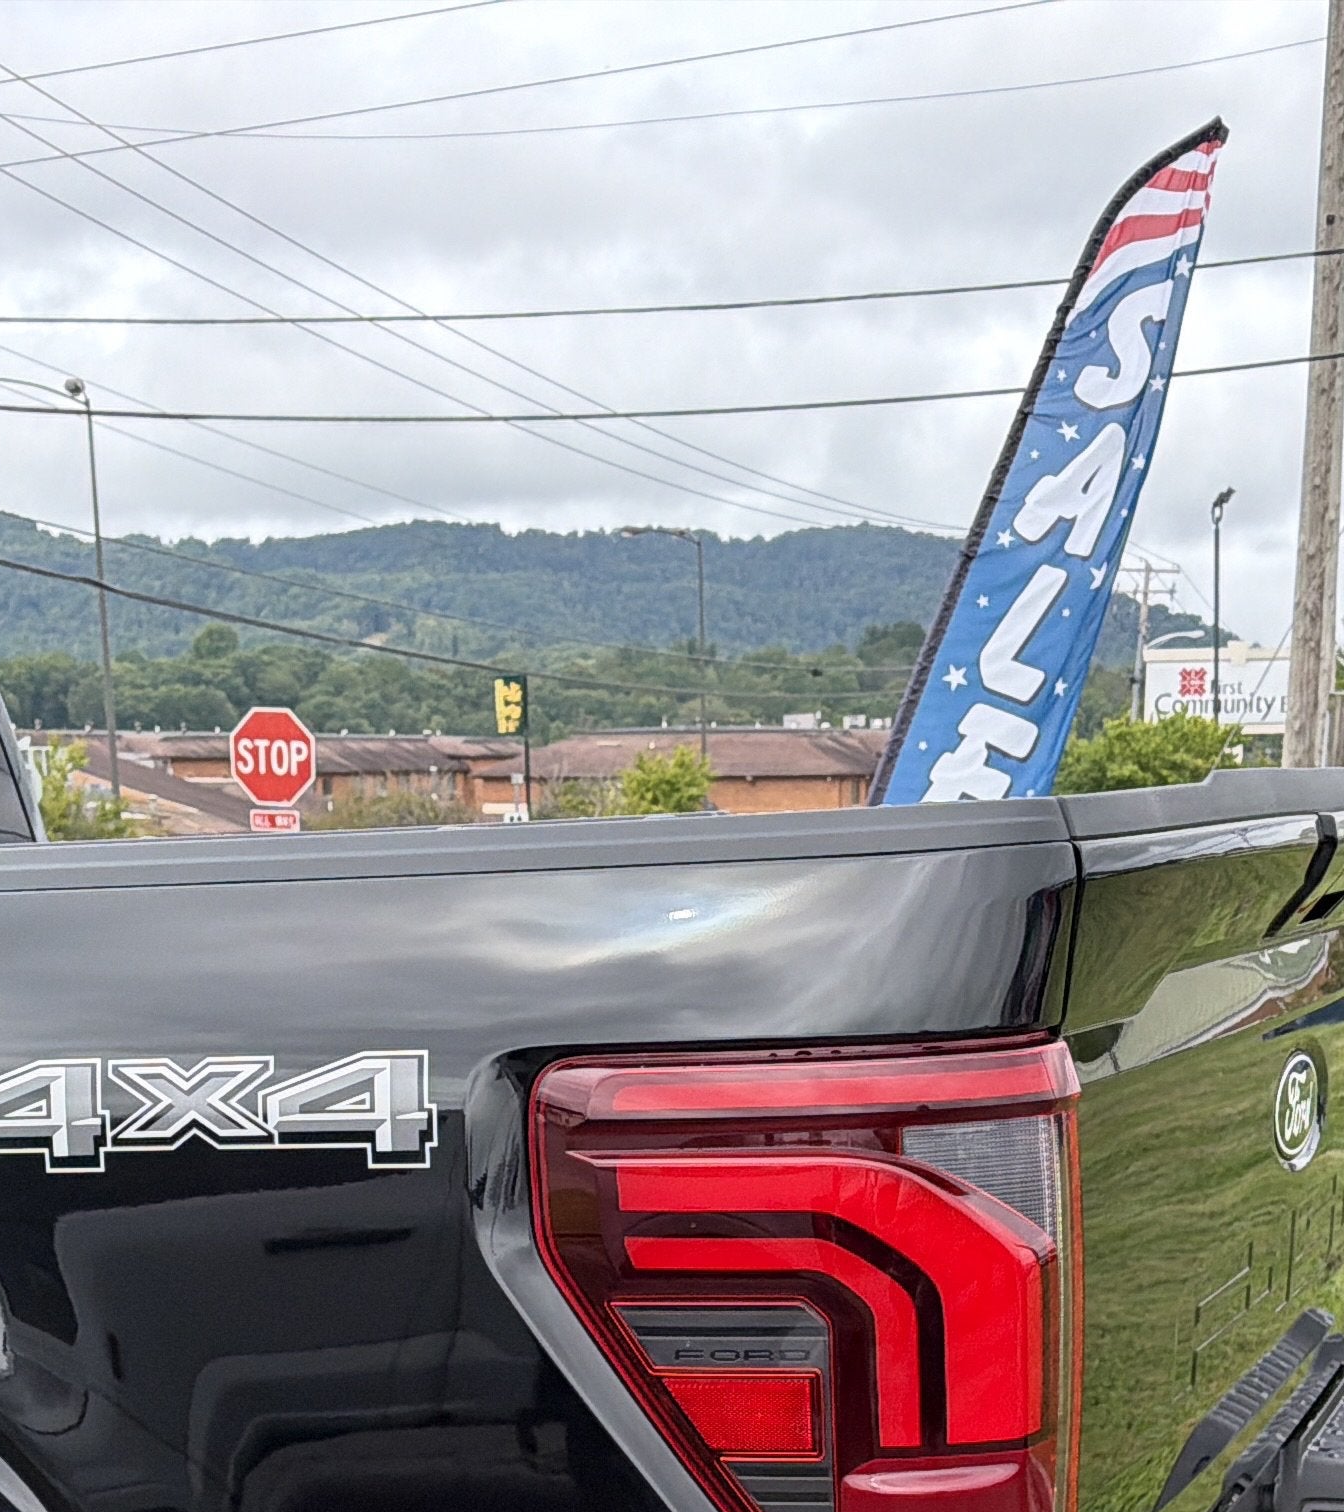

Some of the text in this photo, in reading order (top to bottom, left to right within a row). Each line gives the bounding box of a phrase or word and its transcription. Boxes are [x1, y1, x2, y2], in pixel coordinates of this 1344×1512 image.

[1154, 692, 1276, 721] Community
[236, 737, 309, 777] STOP
[1284, 1068, 1314, 1143] Ford
[675, 1349, 810, 1362] FORD
